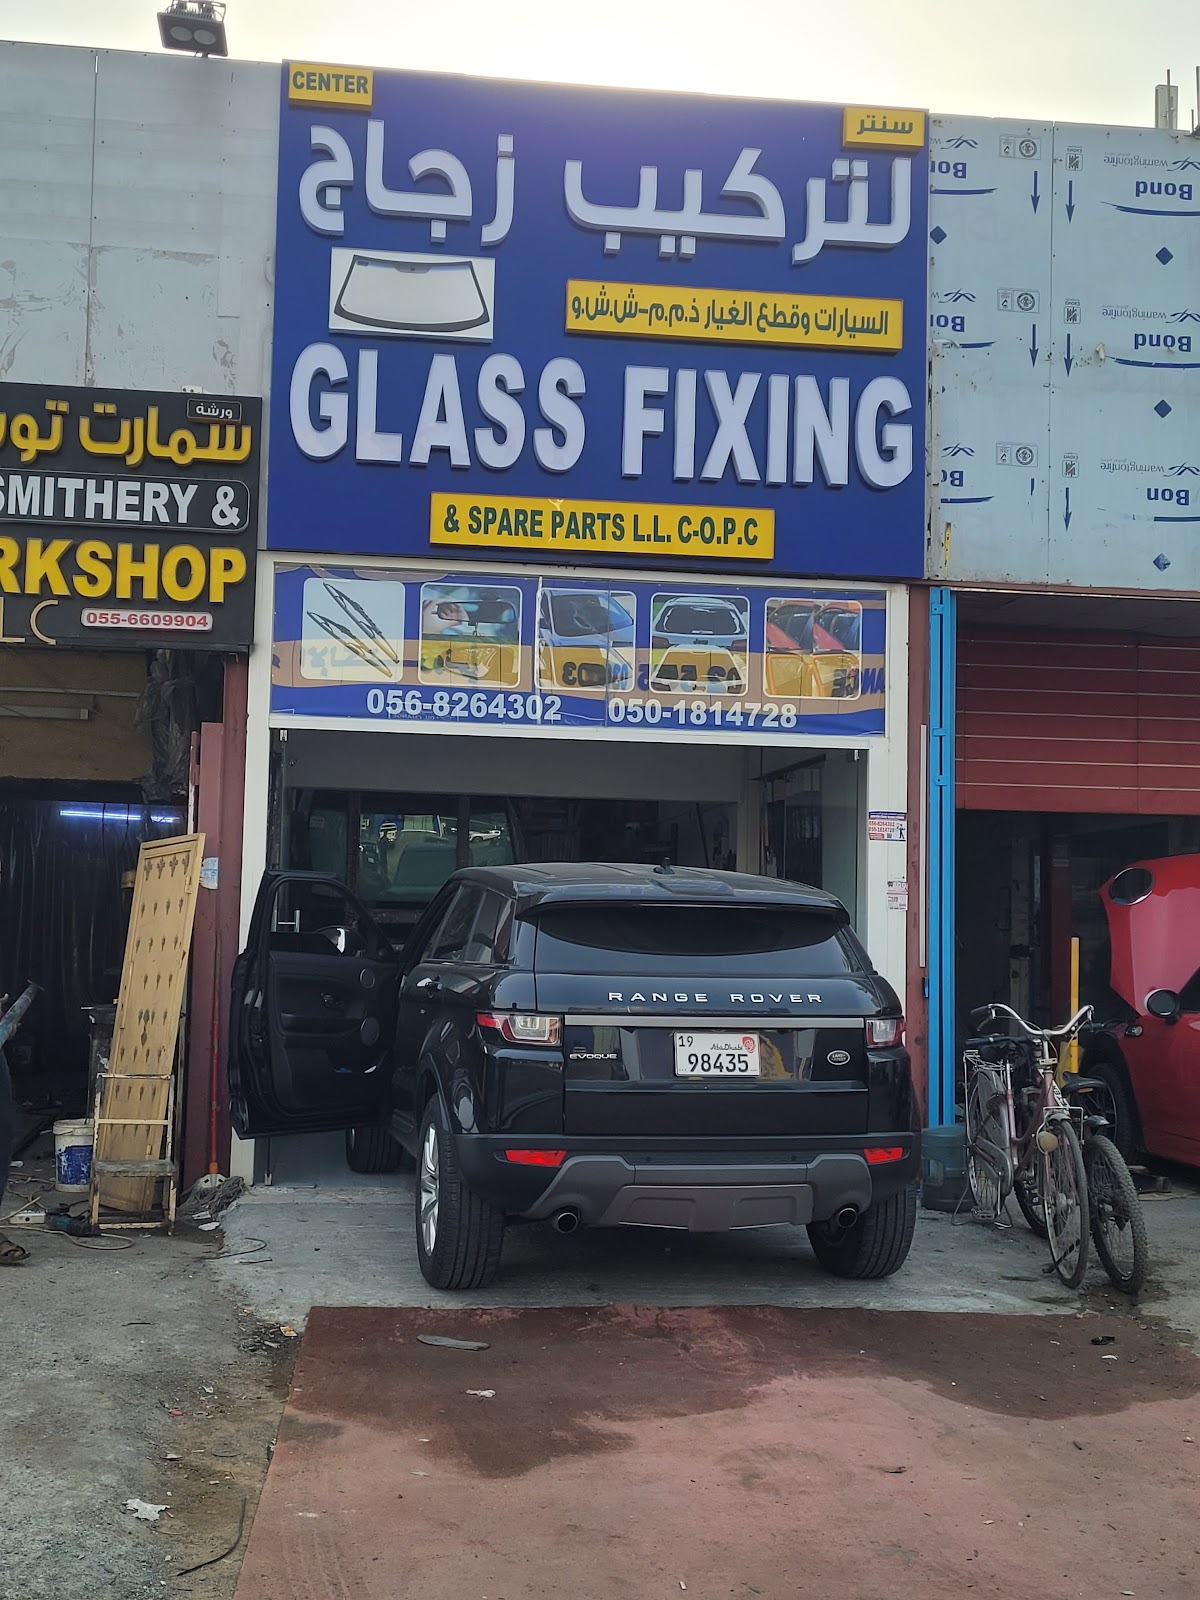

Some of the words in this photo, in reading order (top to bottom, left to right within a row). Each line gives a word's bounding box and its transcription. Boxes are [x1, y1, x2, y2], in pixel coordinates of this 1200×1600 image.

[292, 70, 369, 94] CENTER
[856, 114, 914, 136] سنتر
[1103, 155, 1168, 169] warringtonfire
[299, 118, 515, 247] زجاج
[1135, 180, 1193, 201] Bond
[563, 146, 912, 265] لتركيب
[704, 298, 753, 331] الغيار
[756, 302, 810, 336] وقطع
[814, 306, 889, 339] السيارات
[930, 314, 966, 333] Bo
[1102, 307, 1167, 321] warringtonfire
[1134, 333, 1192, 353] Bond
[289, 341, 587, 474] GLASS
[621, 364, 914, 489] FIXING
[79, 402, 252, 468] سمارت
[1100, 461, 1165, 474] warringtonfire
[0, 474, 199, 524] MITHERY
[211, 485, 241, 527] &
[1146, 487, 1190, 506] Bon
[443, 504, 460, 533] &
[468, 505, 544, 538] SPARE
[551, 510, 625, 542] PARTS
[86, 612, 208, 628] 055-6609904
[366, 688, 562, 721] 056-8264302
[607, 697, 798, 728] 050-1814728
[608, 991, 709, 1002] RANGE
[729, 993, 823, 1003] ROVER
[678, 1035, 694, 1048] 19
[687, 1053, 749, 1073] 98435
